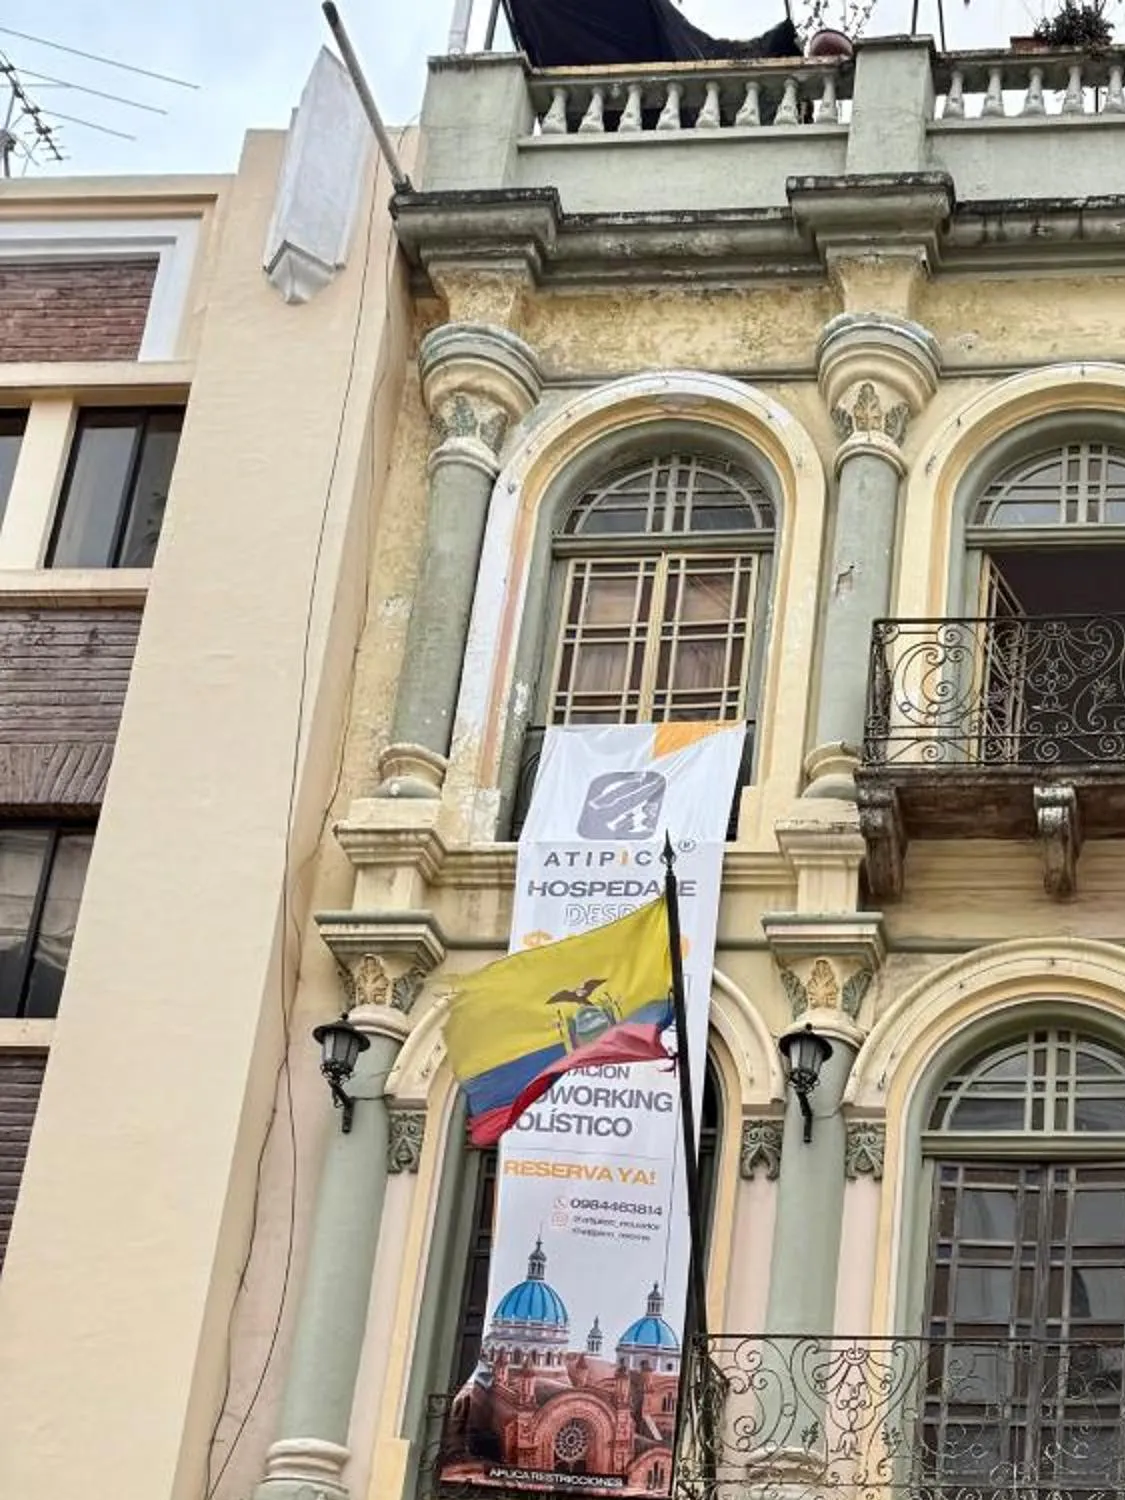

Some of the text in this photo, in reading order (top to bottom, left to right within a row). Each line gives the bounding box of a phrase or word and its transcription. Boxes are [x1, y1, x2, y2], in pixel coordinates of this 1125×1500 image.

[528, 880, 697, 897] HOSPEDAE
[536, 1085, 673, 1113] WORKING
[515, 1108, 633, 1138] OLÍSTICO
[504, 1160, 656, 1185] RESERVA YA!
